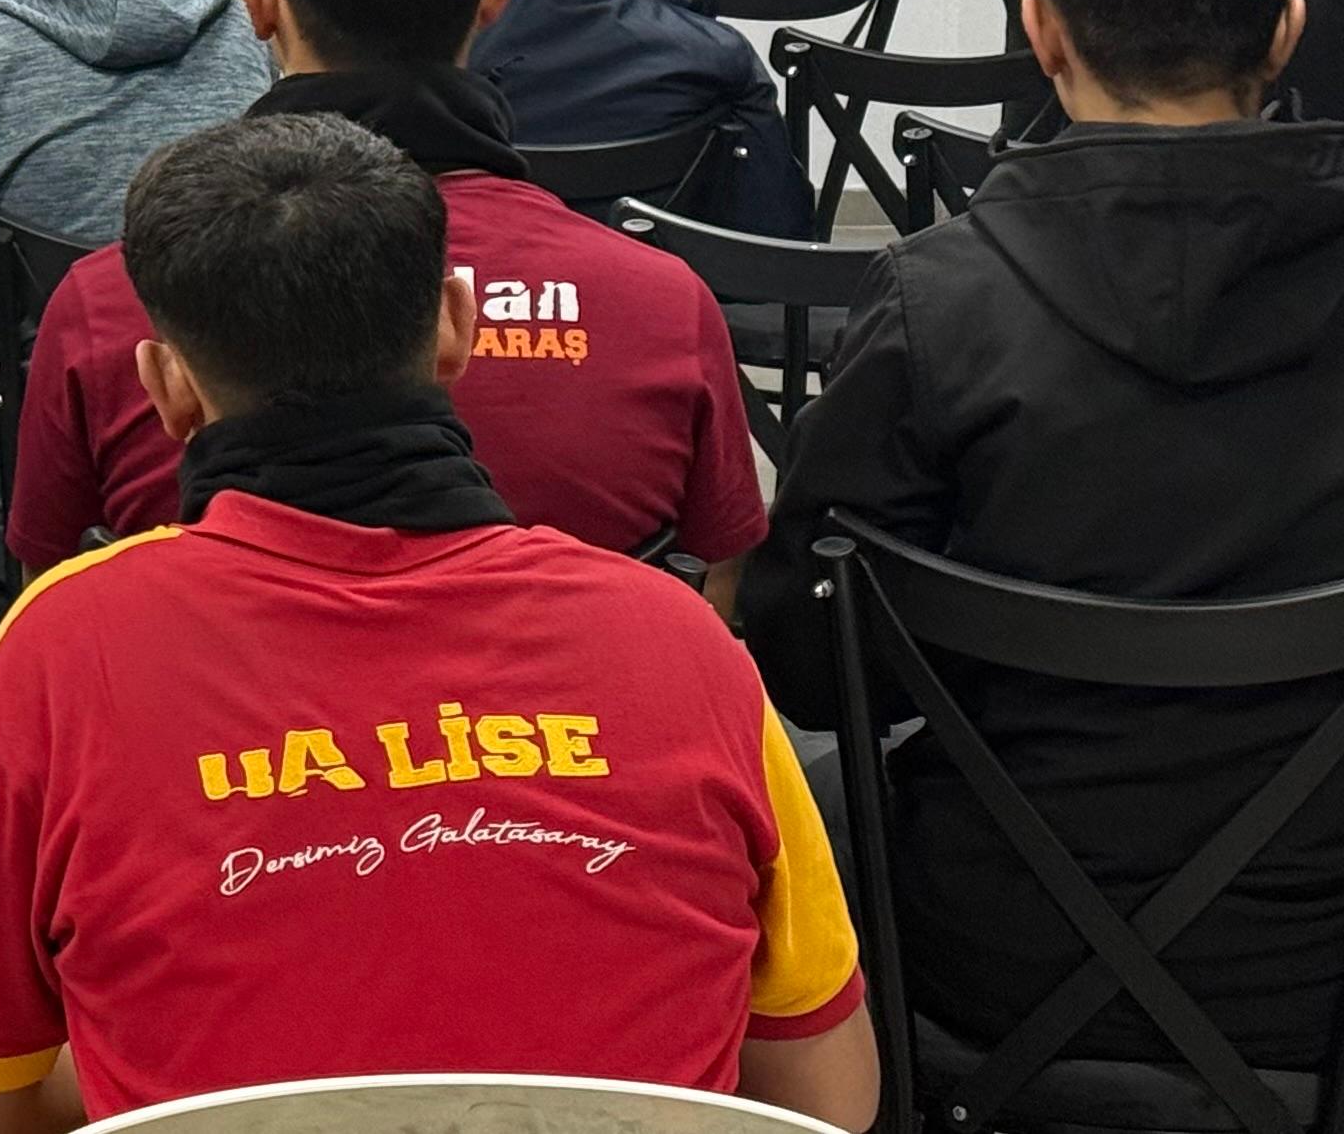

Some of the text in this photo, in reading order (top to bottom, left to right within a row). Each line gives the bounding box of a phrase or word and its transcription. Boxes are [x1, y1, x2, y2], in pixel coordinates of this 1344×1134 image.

[375, 701, 611, 789] LİSE
[219, 807, 637, 897] Dersimiz Galatasaray
